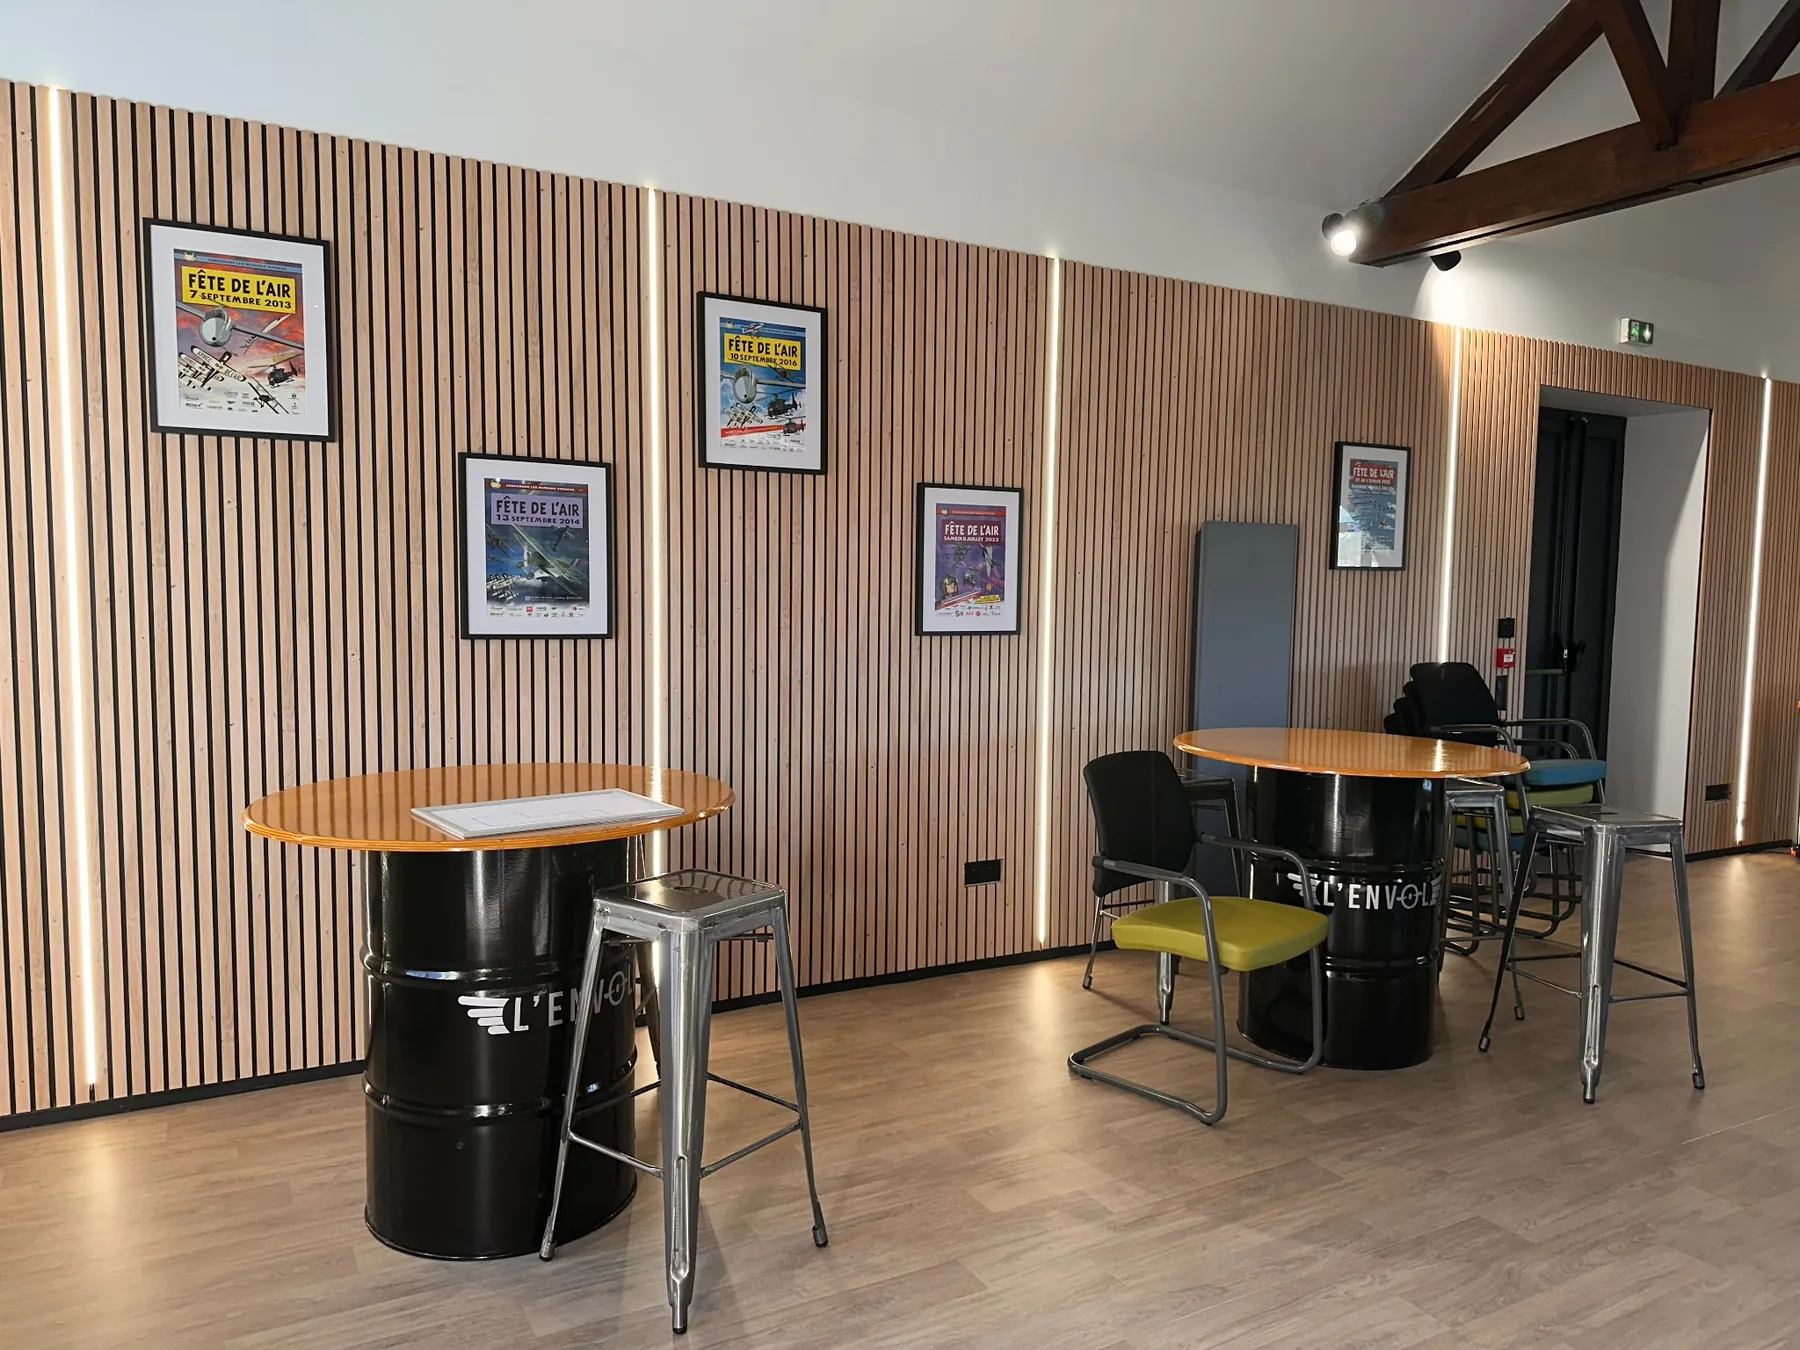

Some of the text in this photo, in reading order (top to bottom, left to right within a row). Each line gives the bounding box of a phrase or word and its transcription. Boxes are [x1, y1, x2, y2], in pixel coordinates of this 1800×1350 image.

[188, 269, 291, 298] FÊTE DE L'AIR
[190, 290, 291, 309] 7 SEPTEMBRE 2013
[729, 336, 797, 358] FÊTE DE L'AIR
[740, 354, 777, 364] SEPTEMBRE
[1370, 468, 1378, 478] DE
[496, 496, 579, 516] FÊTE DE L'AIR
[945, 521, 999, 536] FÊTE DE L'AIR
[1323, 881, 1428, 910] L'ENVOL
